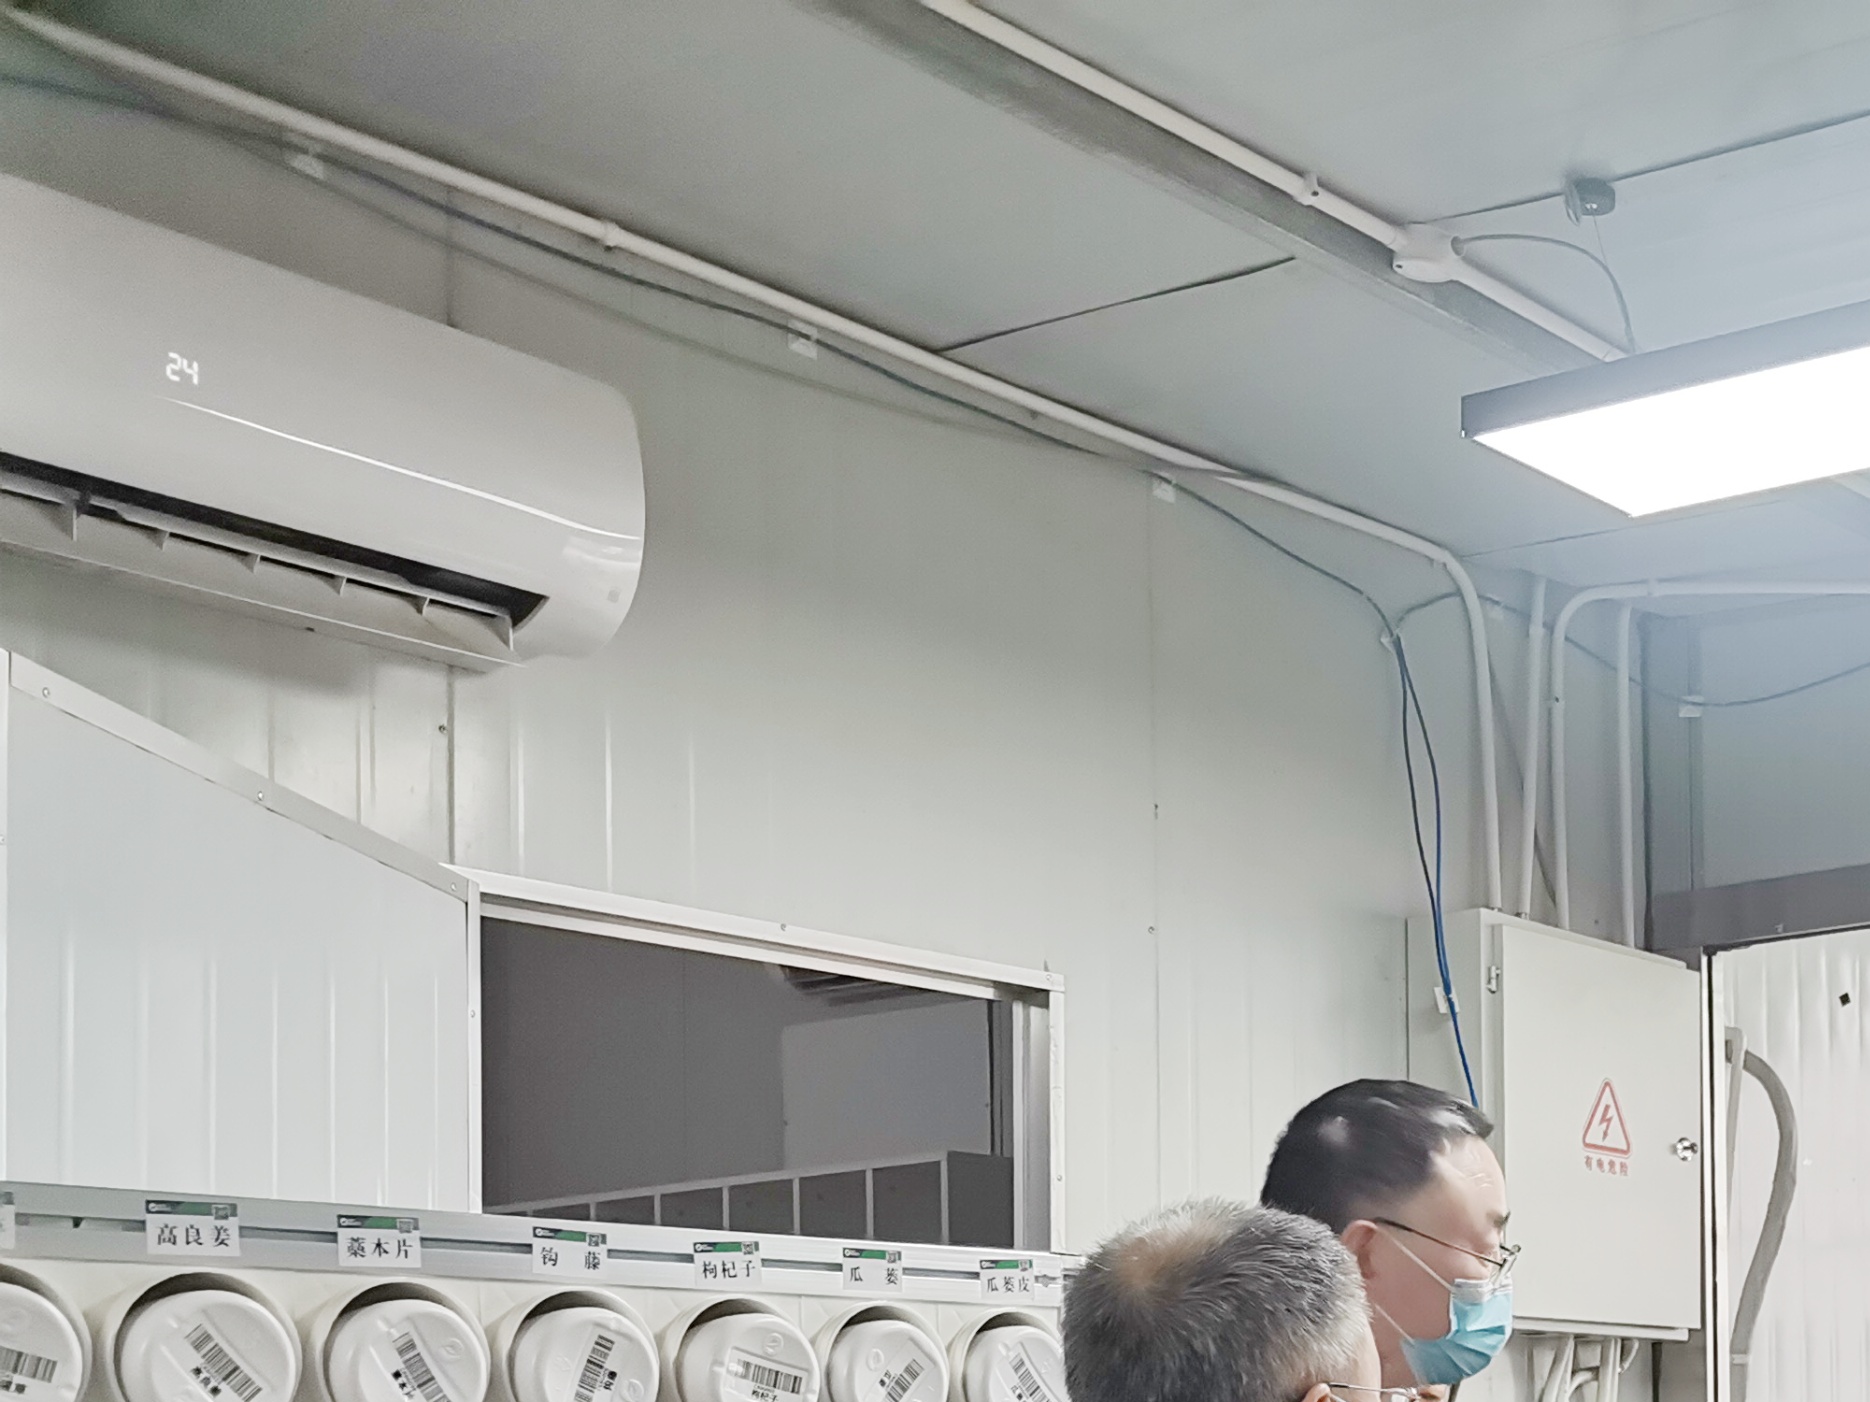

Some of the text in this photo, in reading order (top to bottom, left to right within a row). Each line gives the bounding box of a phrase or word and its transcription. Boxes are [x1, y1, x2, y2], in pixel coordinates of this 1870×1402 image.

[166, 352, 199, 385] 24
[1584, 1155, 1628, 1177] 有电危险
[157, 1223, 231, 1247] 高良姜
[701, 1259, 756, 1280] 枸杞子
[986, 1274, 1031, 1294] 瓜蒌皮
